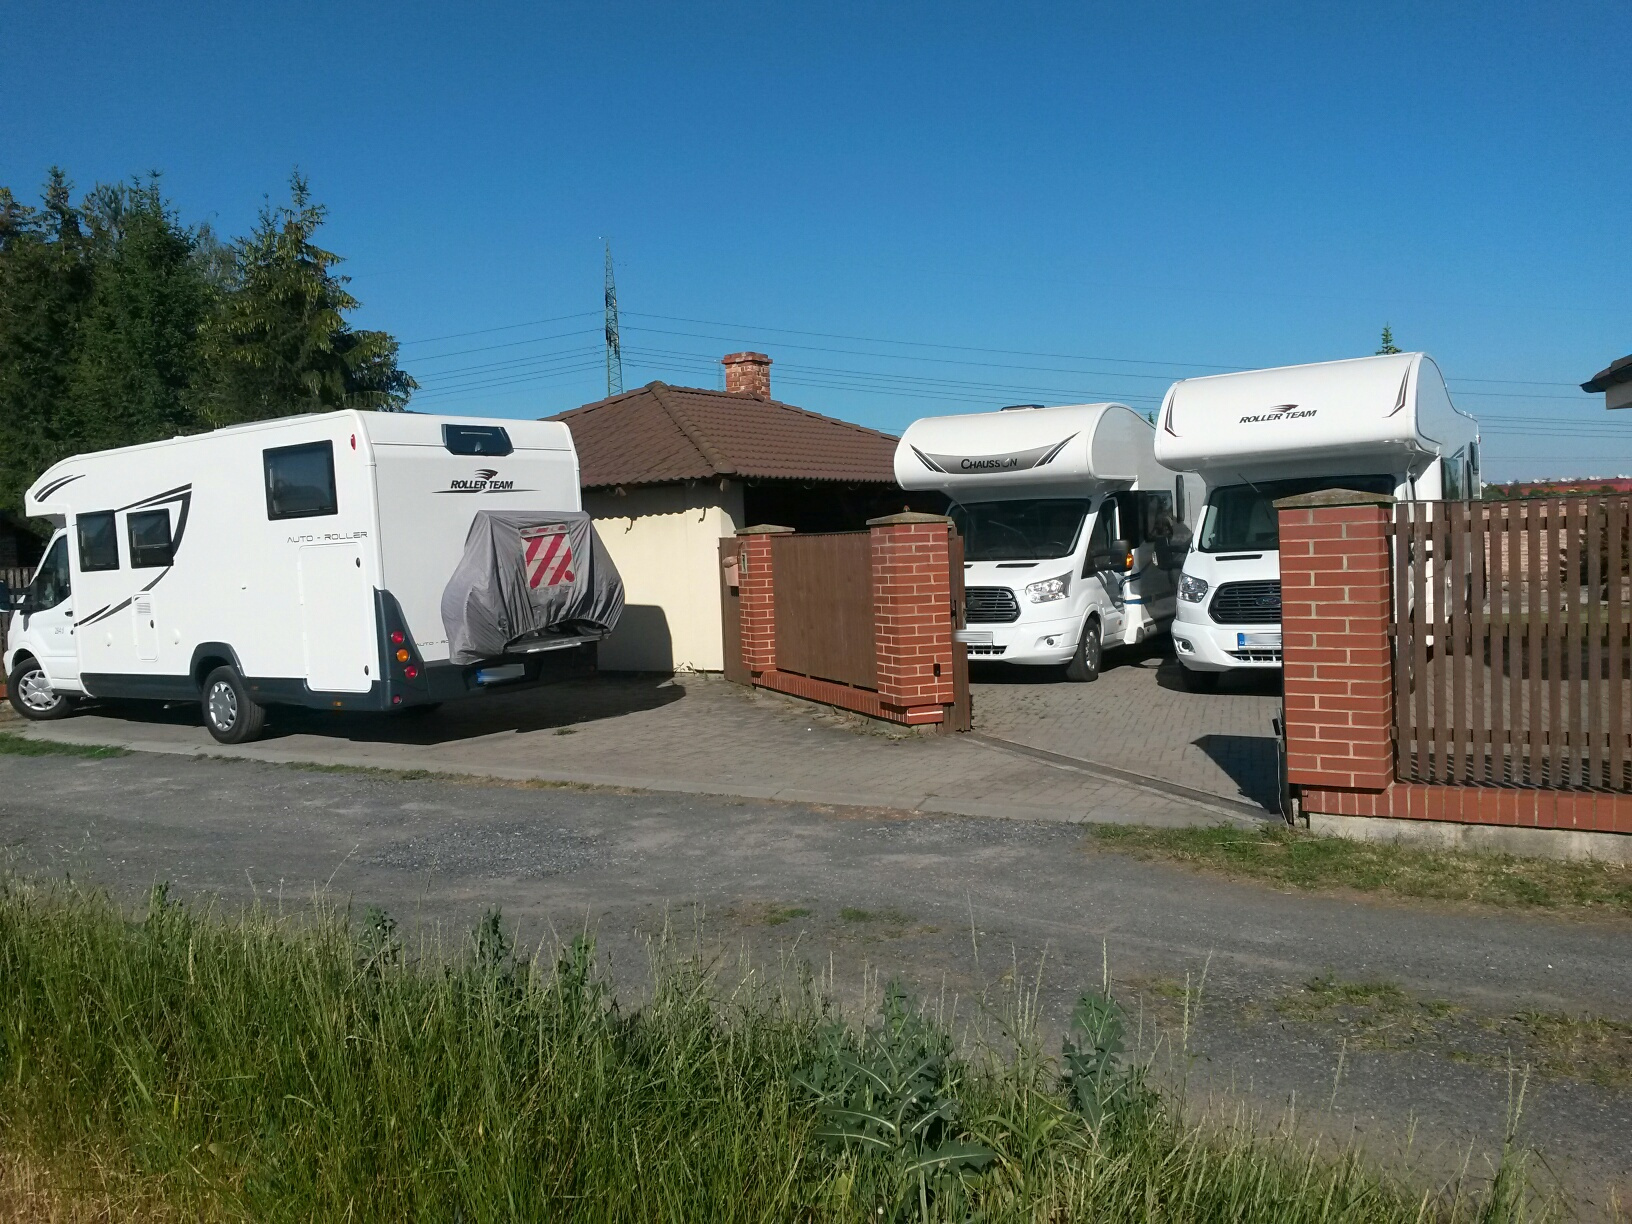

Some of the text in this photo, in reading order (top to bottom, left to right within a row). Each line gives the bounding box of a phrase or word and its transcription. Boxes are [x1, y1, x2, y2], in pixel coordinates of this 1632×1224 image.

[1239, 409, 1318, 424] ROLLER TEAM
[450, 480, 514, 489] ROLLER TEAM
[287, 535, 314, 544] AUTO
[324, 531, 368, 541] ROLLER
